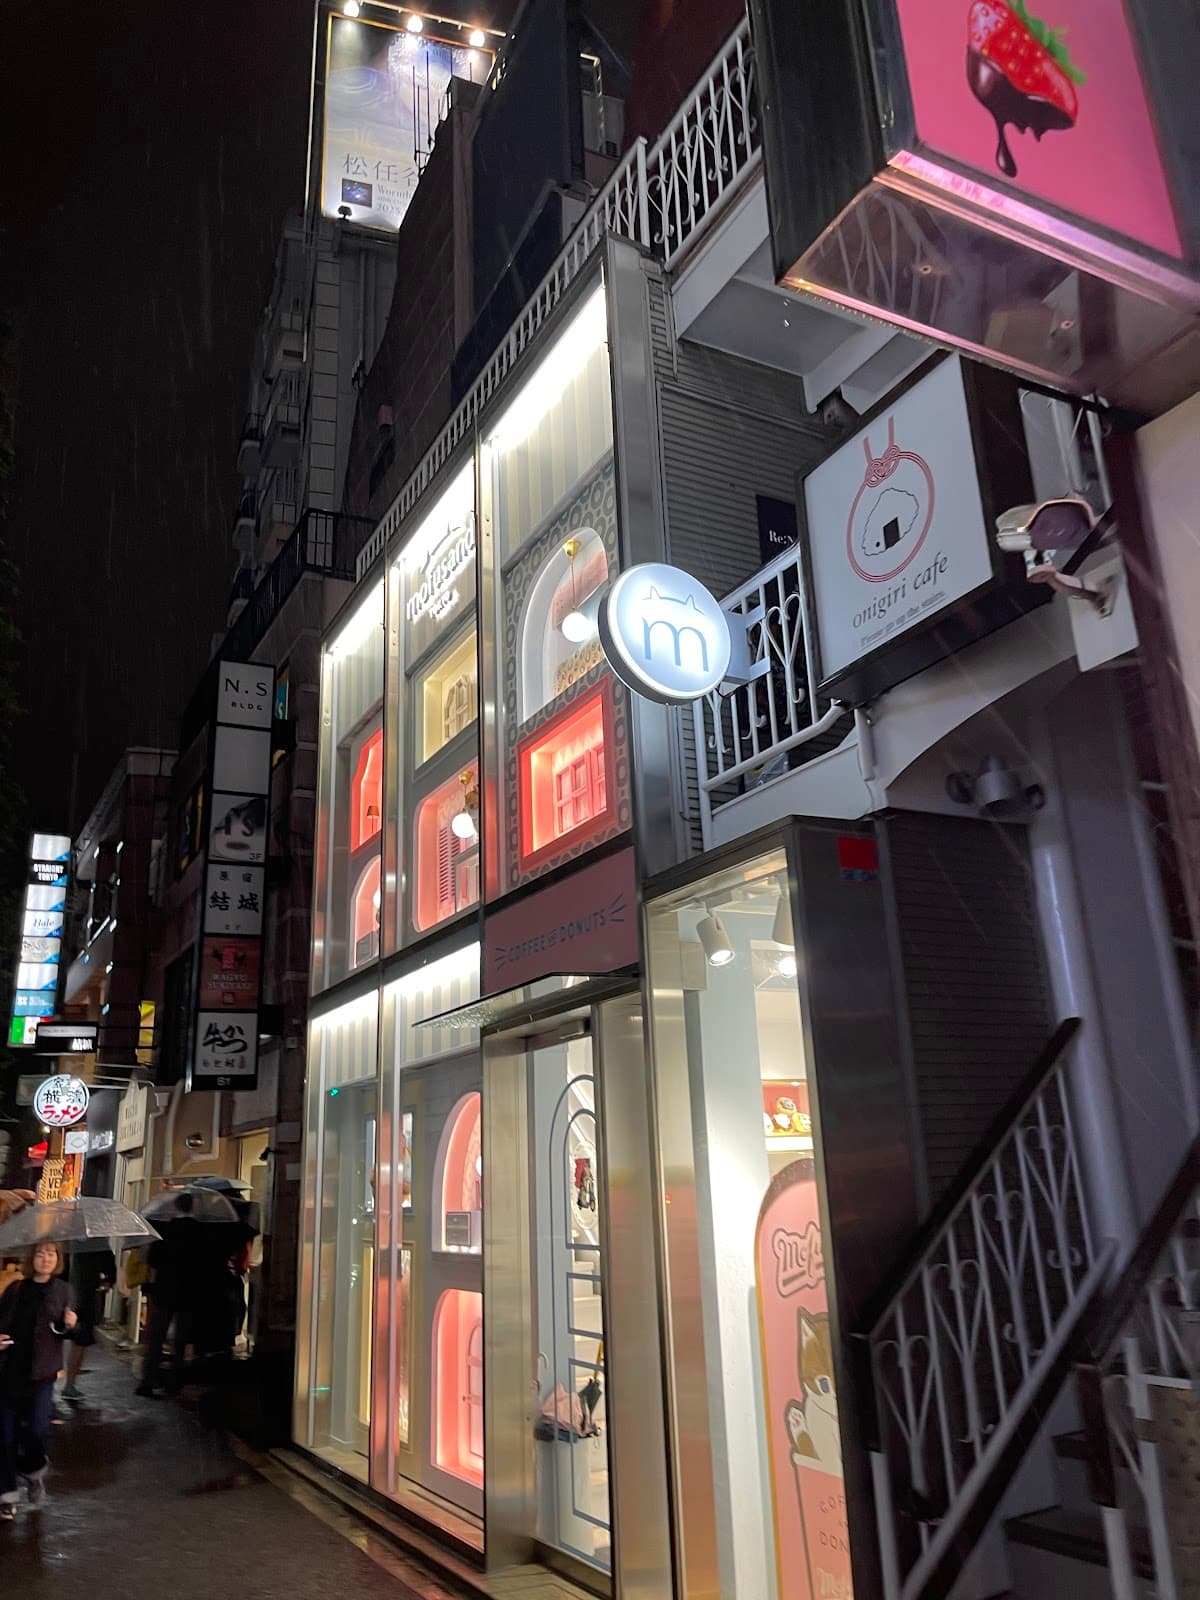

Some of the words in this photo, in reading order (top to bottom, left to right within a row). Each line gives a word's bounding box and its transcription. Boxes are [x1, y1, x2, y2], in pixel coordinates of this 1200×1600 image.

[406, 514, 475, 622] mofusand
[852, 577, 907, 629] onigiri
[641, 617, 709, 672] m
[224, 678, 267, 696] N.S
[231, 701, 263, 711] BLDG
[34, 864, 64, 873] STRAIGHT
[38, 873, 58, 881] TOKYO
[209, 891, 259, 913] 結城
[507, 933, 545, 963] COFFEE
[559, 908, 606, 943] DONUTS
[202, 1022, 248, 1054] 牛かつ
[43, 1104, 85, 1123] ラーメン
